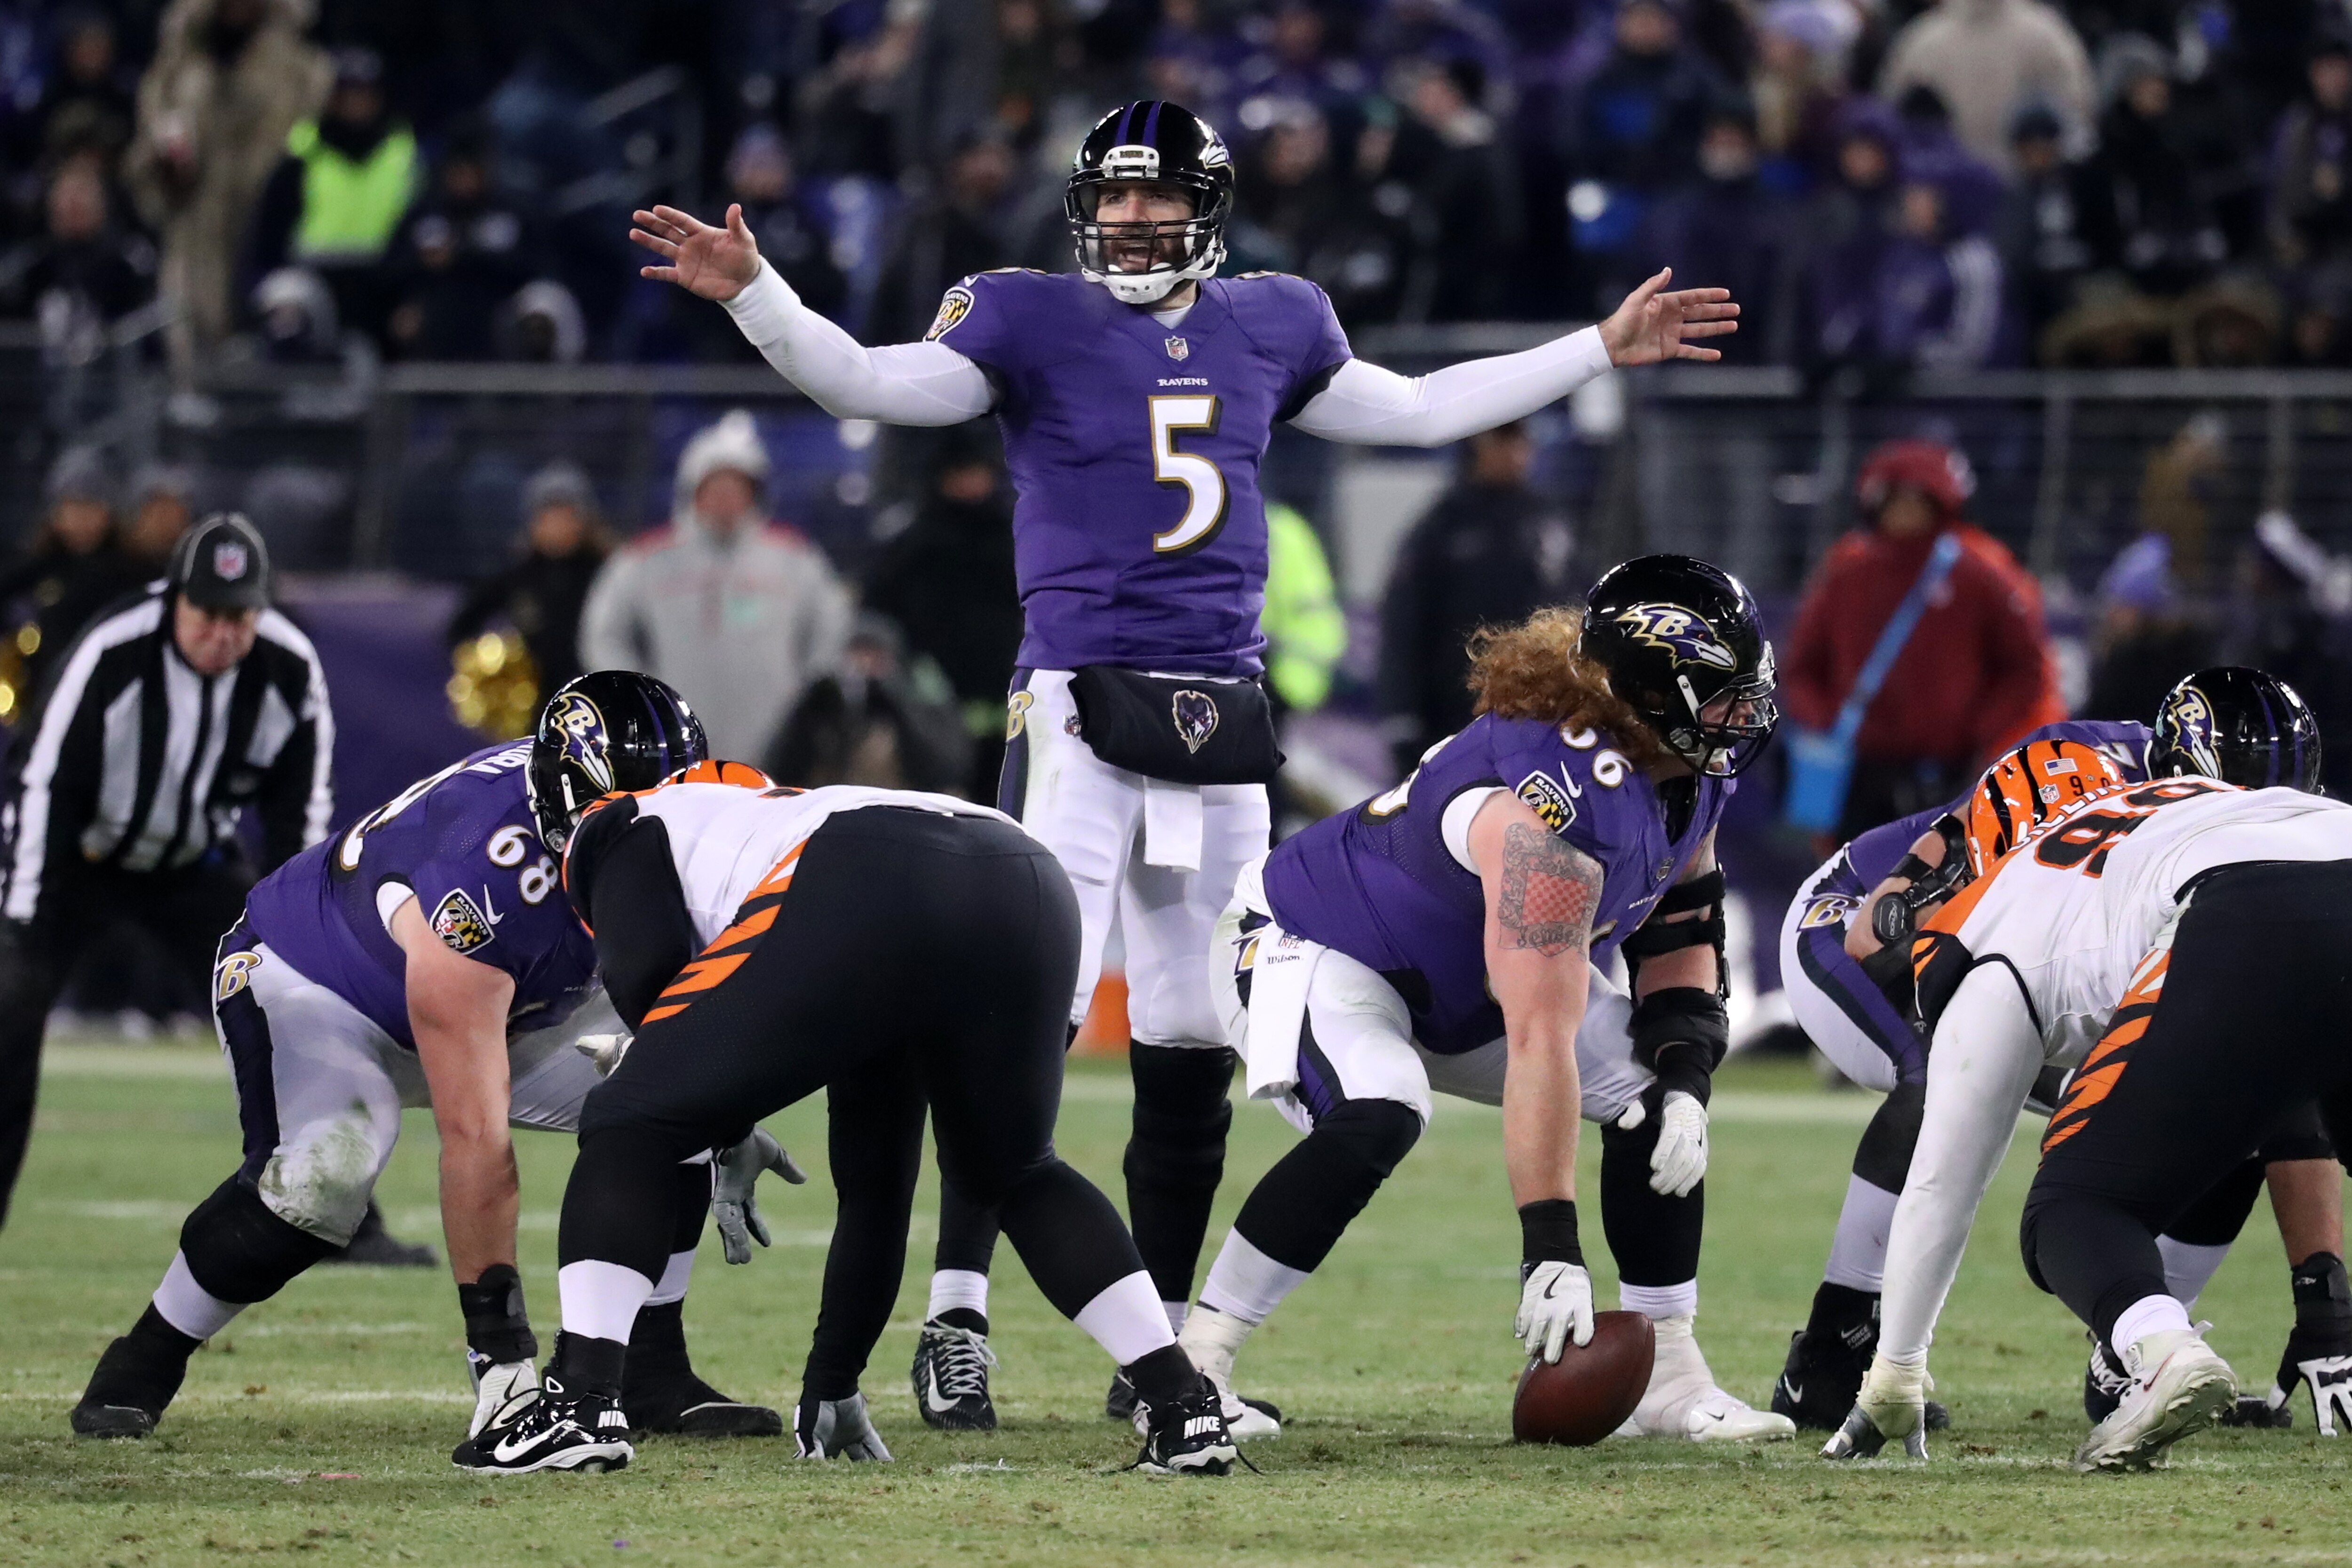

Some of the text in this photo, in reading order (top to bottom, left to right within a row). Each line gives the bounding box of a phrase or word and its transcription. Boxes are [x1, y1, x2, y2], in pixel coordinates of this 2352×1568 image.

[1157, 378, 1208, 386] RAVENS
[1148, 394, 1231, 559] 5
[1535, 777, 1570, 816] RAVENS
[486, 824, 559, 906] 68
[457, 896, 487, 935] RAVENS
[1267, 955, 1300, 964] Wilson
[1280, 939, 1300, 949] NFL
[215, 950, 263, 1003] B
[1183, 1416, 1220, 1440] NIKE
